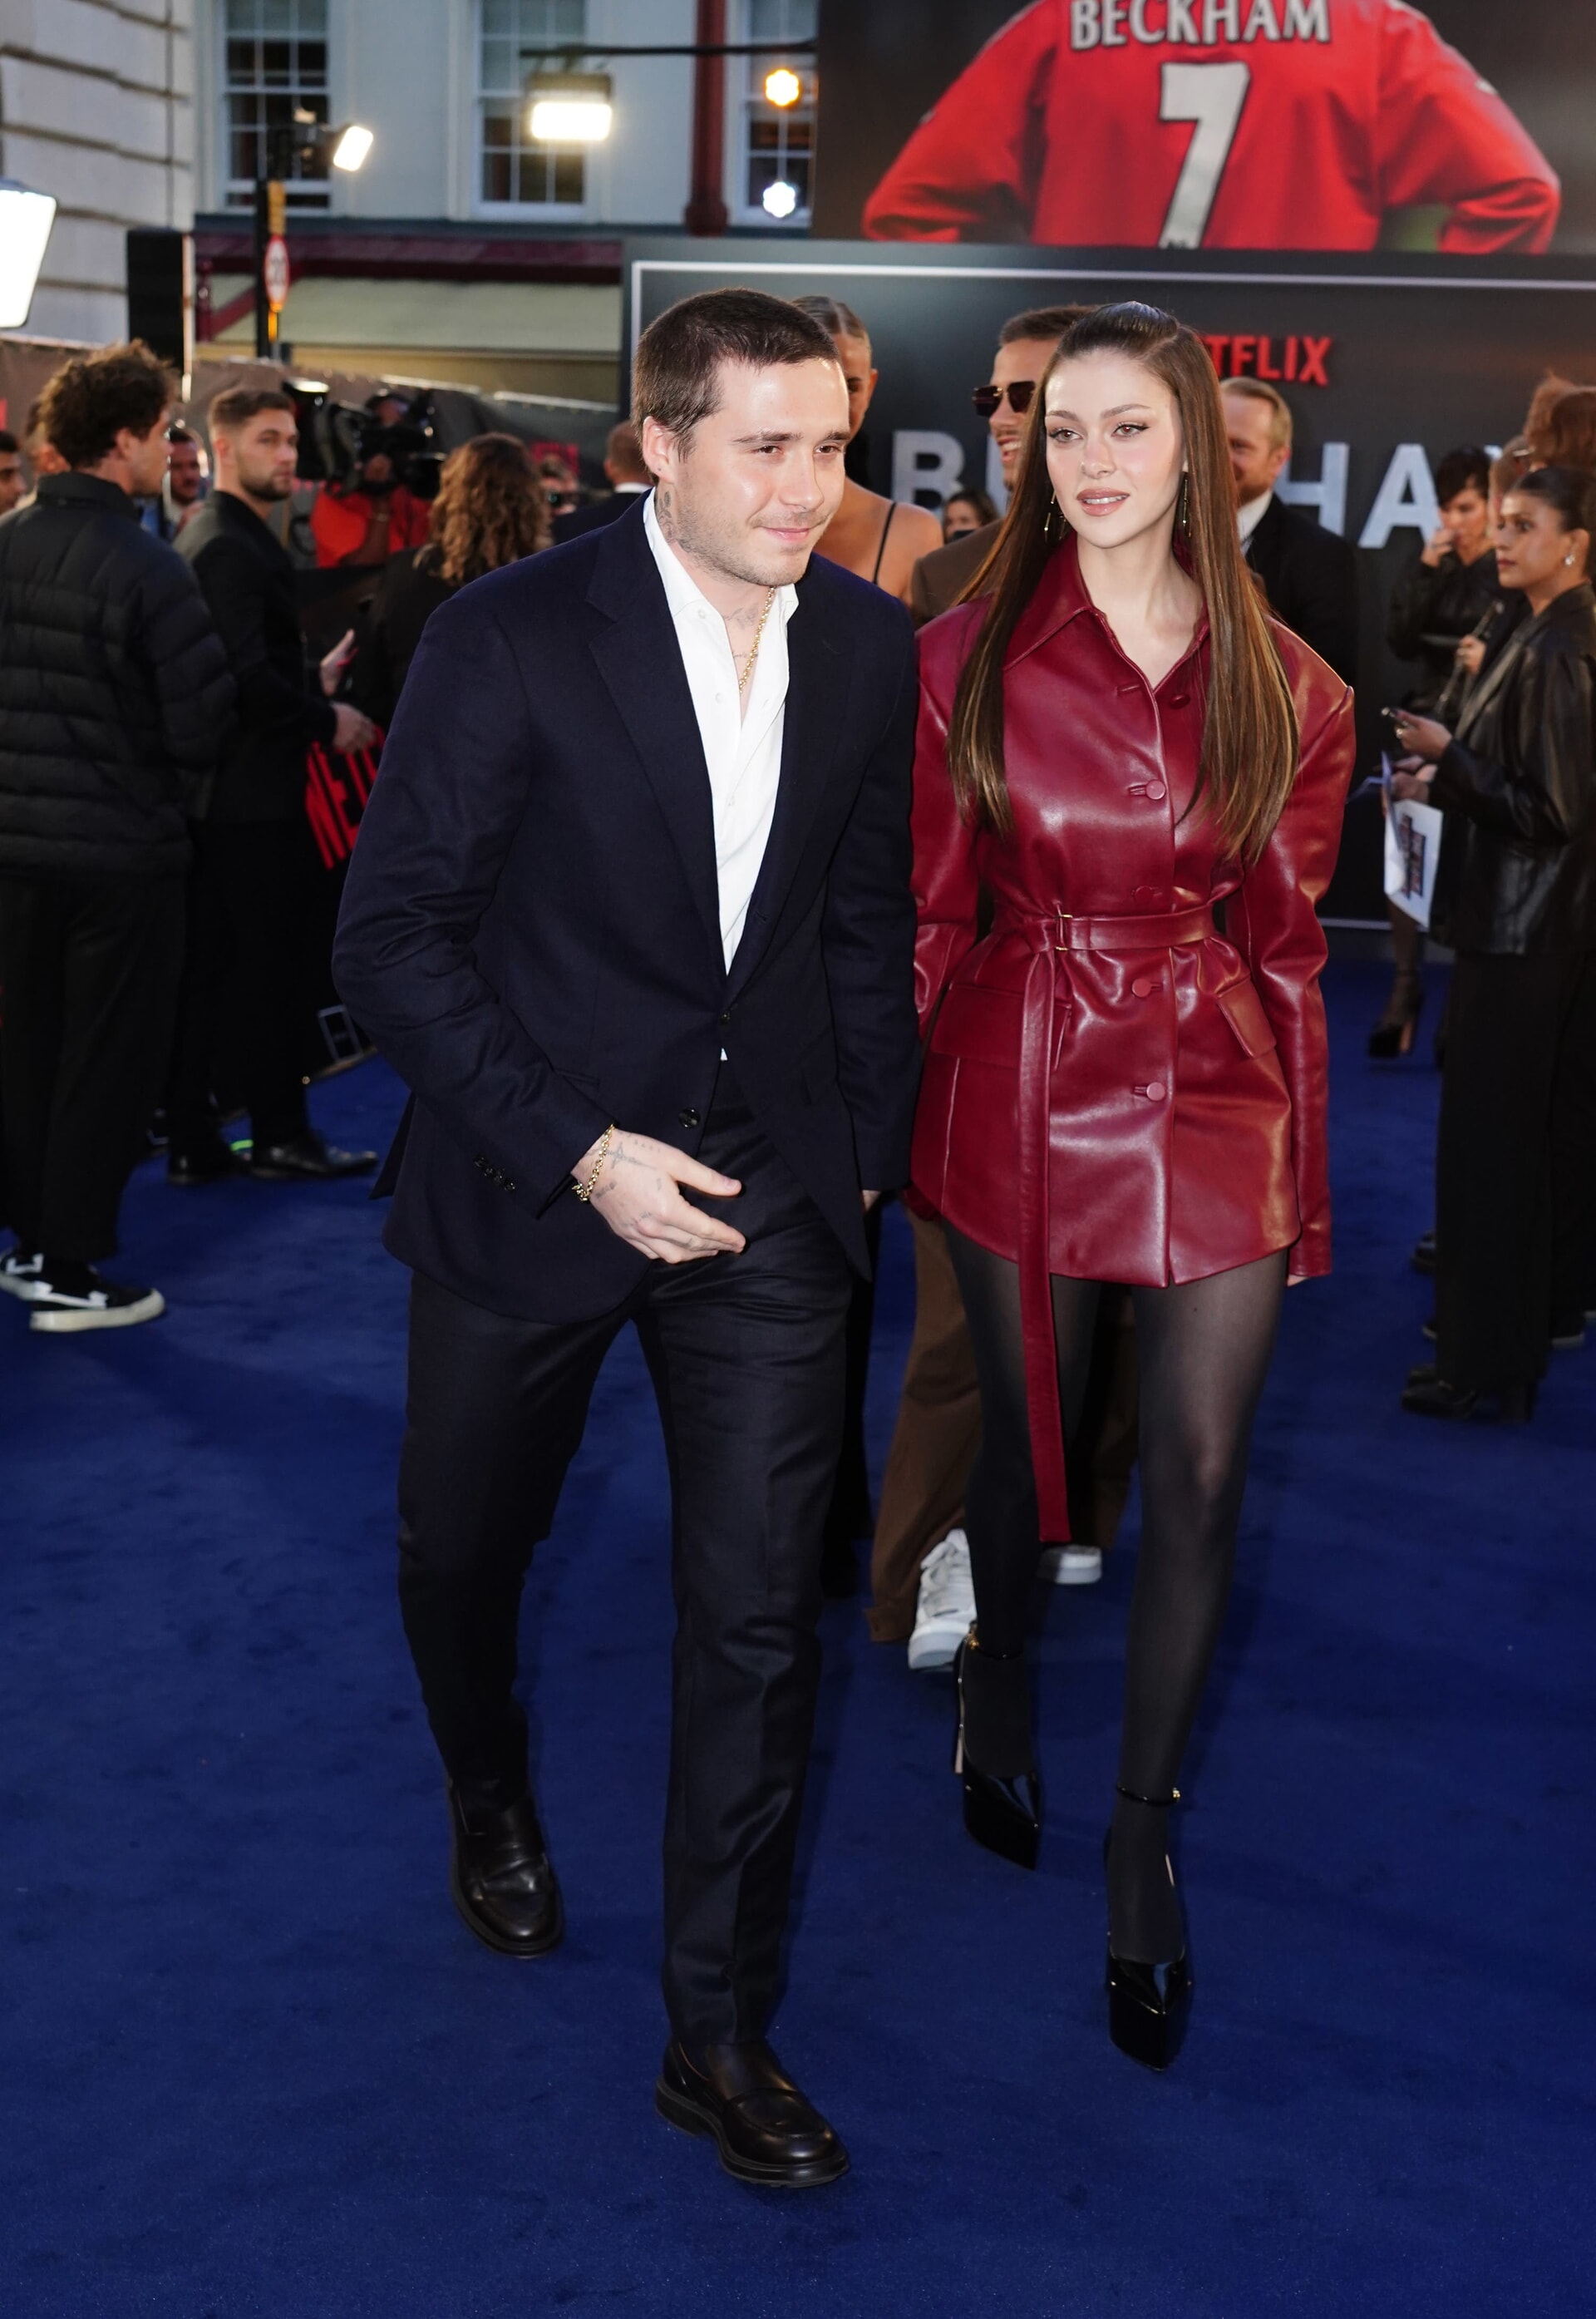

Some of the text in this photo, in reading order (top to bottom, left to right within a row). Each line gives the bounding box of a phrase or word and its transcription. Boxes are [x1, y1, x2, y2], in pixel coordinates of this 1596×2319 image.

[1071, 0, 1331, 50] BECKHAM
[1158, 60, 1251, 249] 7
[1199, 333, 1332, 387] TFLIX
